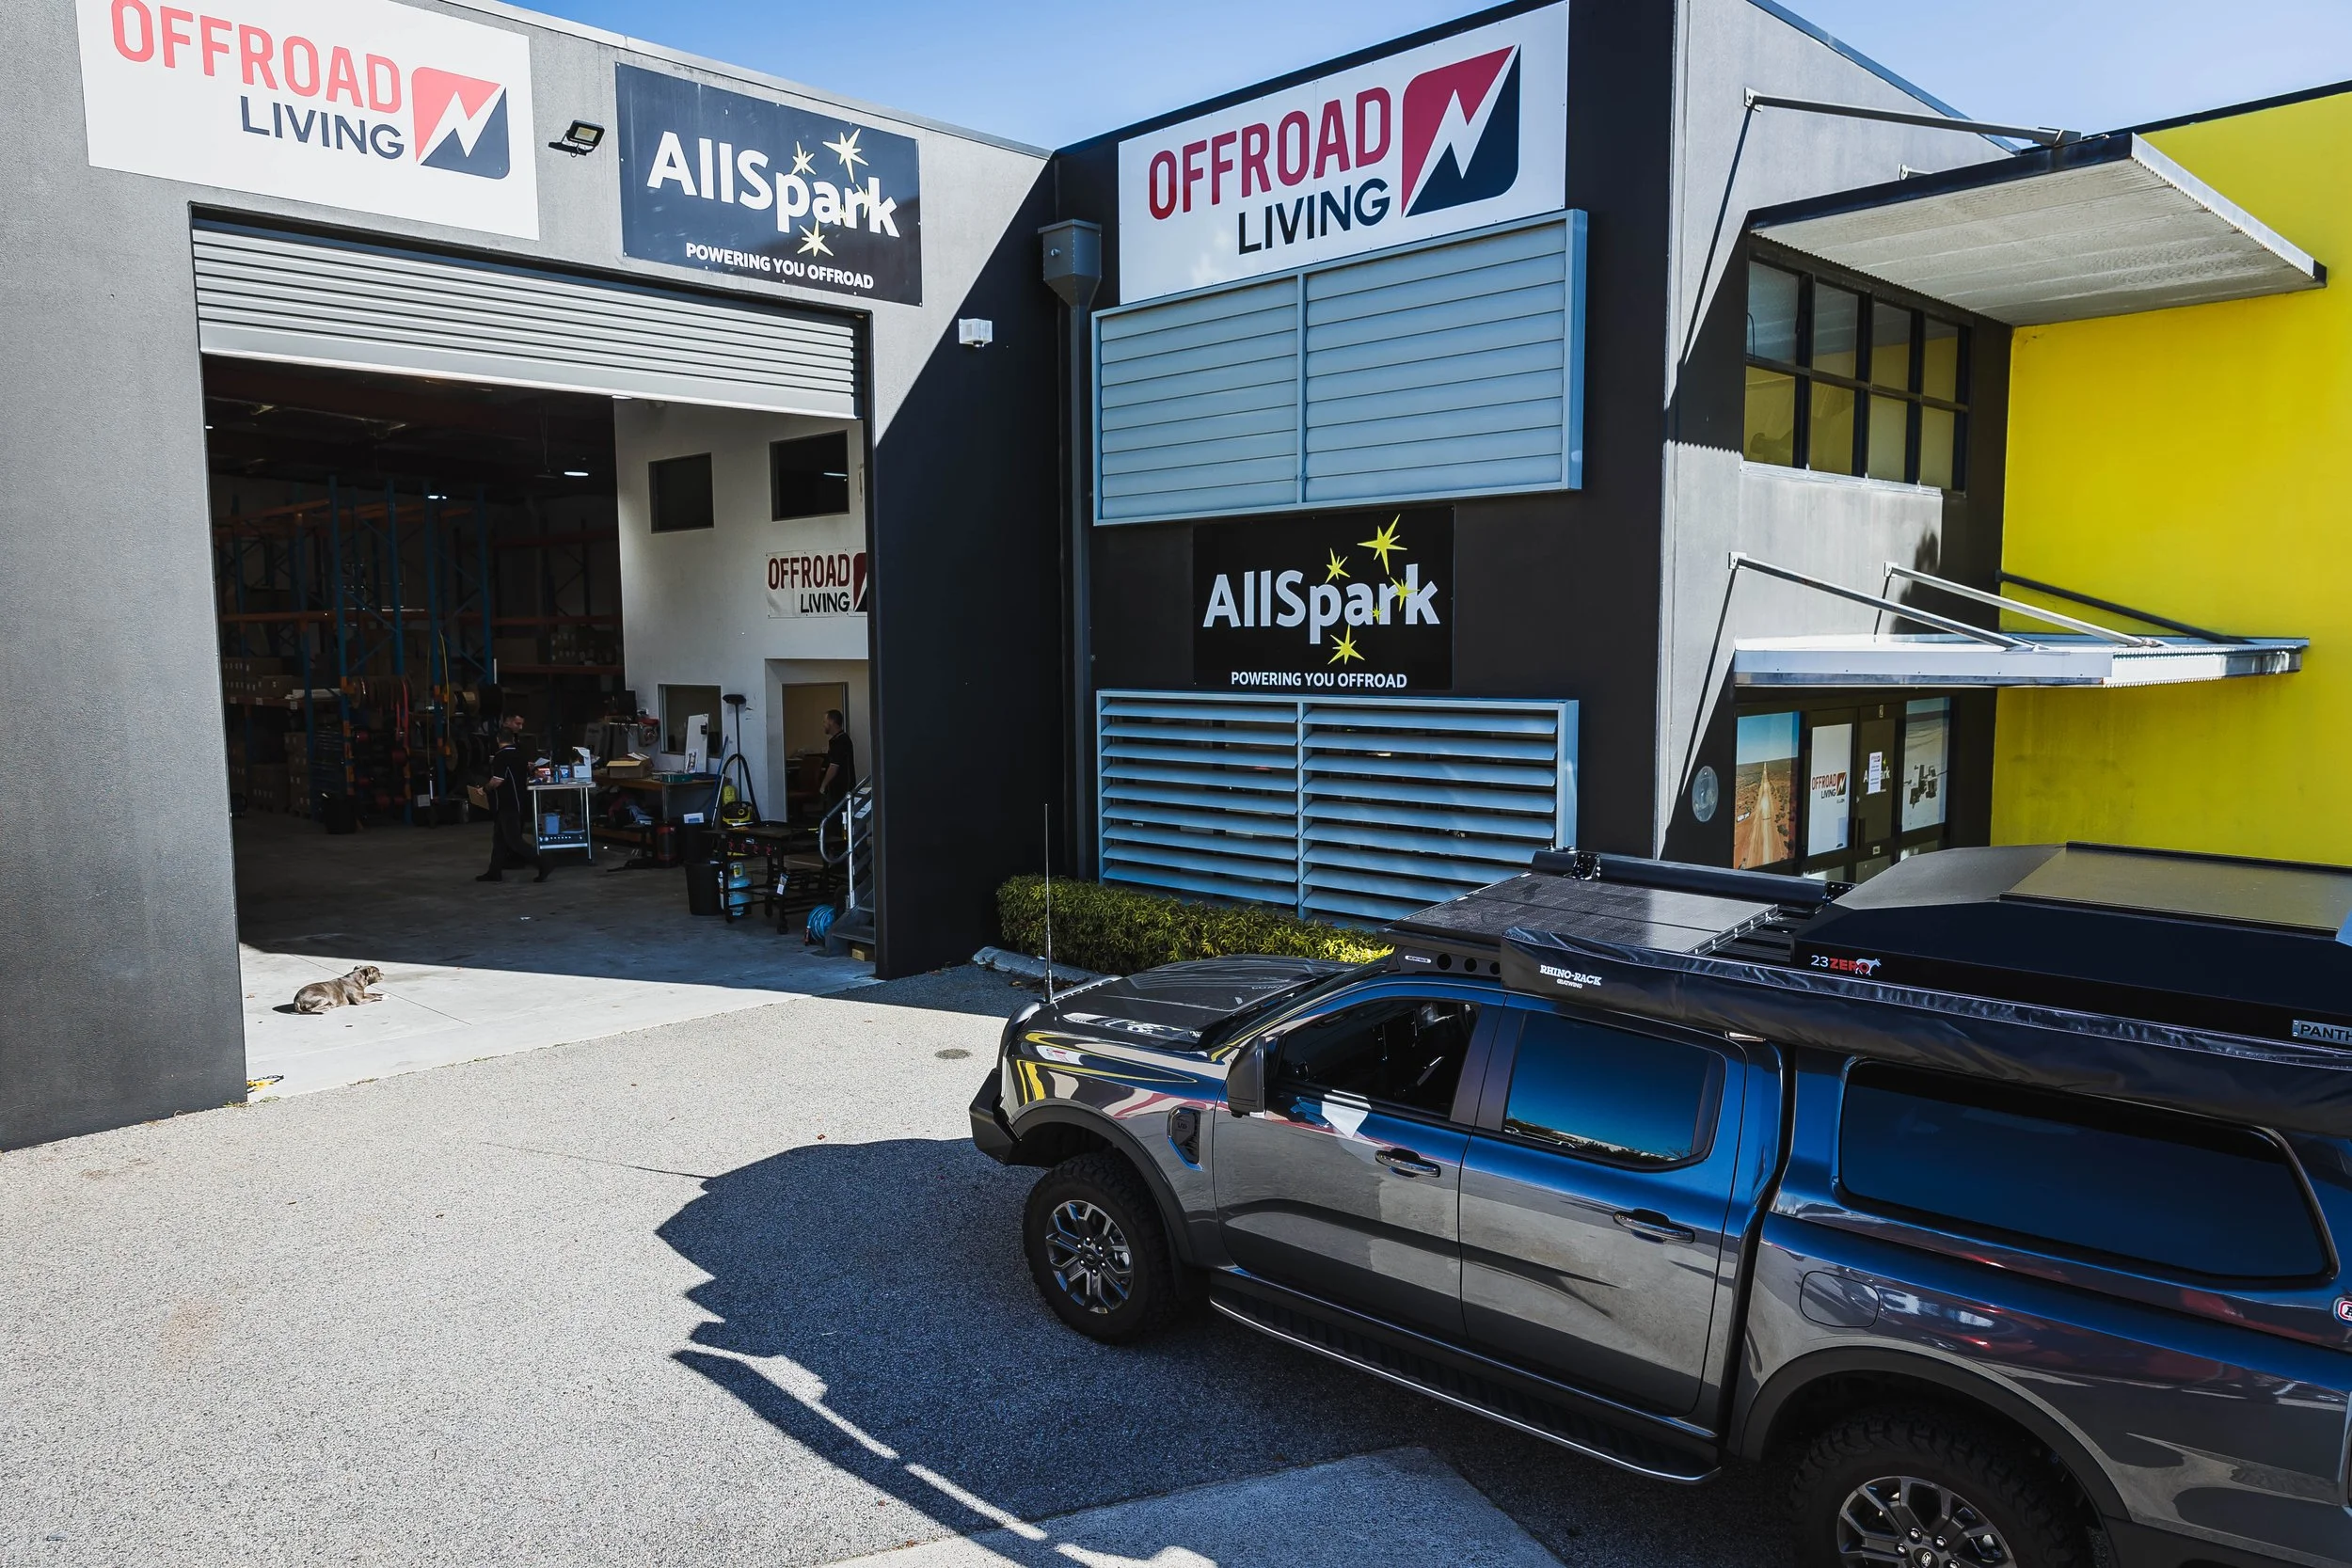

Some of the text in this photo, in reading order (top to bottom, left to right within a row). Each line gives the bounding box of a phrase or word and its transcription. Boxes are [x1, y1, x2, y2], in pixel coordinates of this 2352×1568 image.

[111, 0, 402, 114] OFFROAD
[240, 95, 405, 160] LIVING
[1149, 87, 1391, 221] OFFROAD
[646, 130, 900, 238] AllSpark
[1238, 178, 1391, 256] LIVING
[686, 242, 874, 290] POWERING YOU OFFROAD
[768, 553, 850, 591] OFFROAD
[800, 591, 850, 614] LIVING
[1202, 563, 1440, 644] AllSpark
[1231, 671, 1407, 689] POWERING YOU OFFROAD
[1811, 773, 1836, 790] OFFROAD
[1820, 788, 1836, 800] LIVING
[1539, 964, 1602, 987] RHINO-RACK
